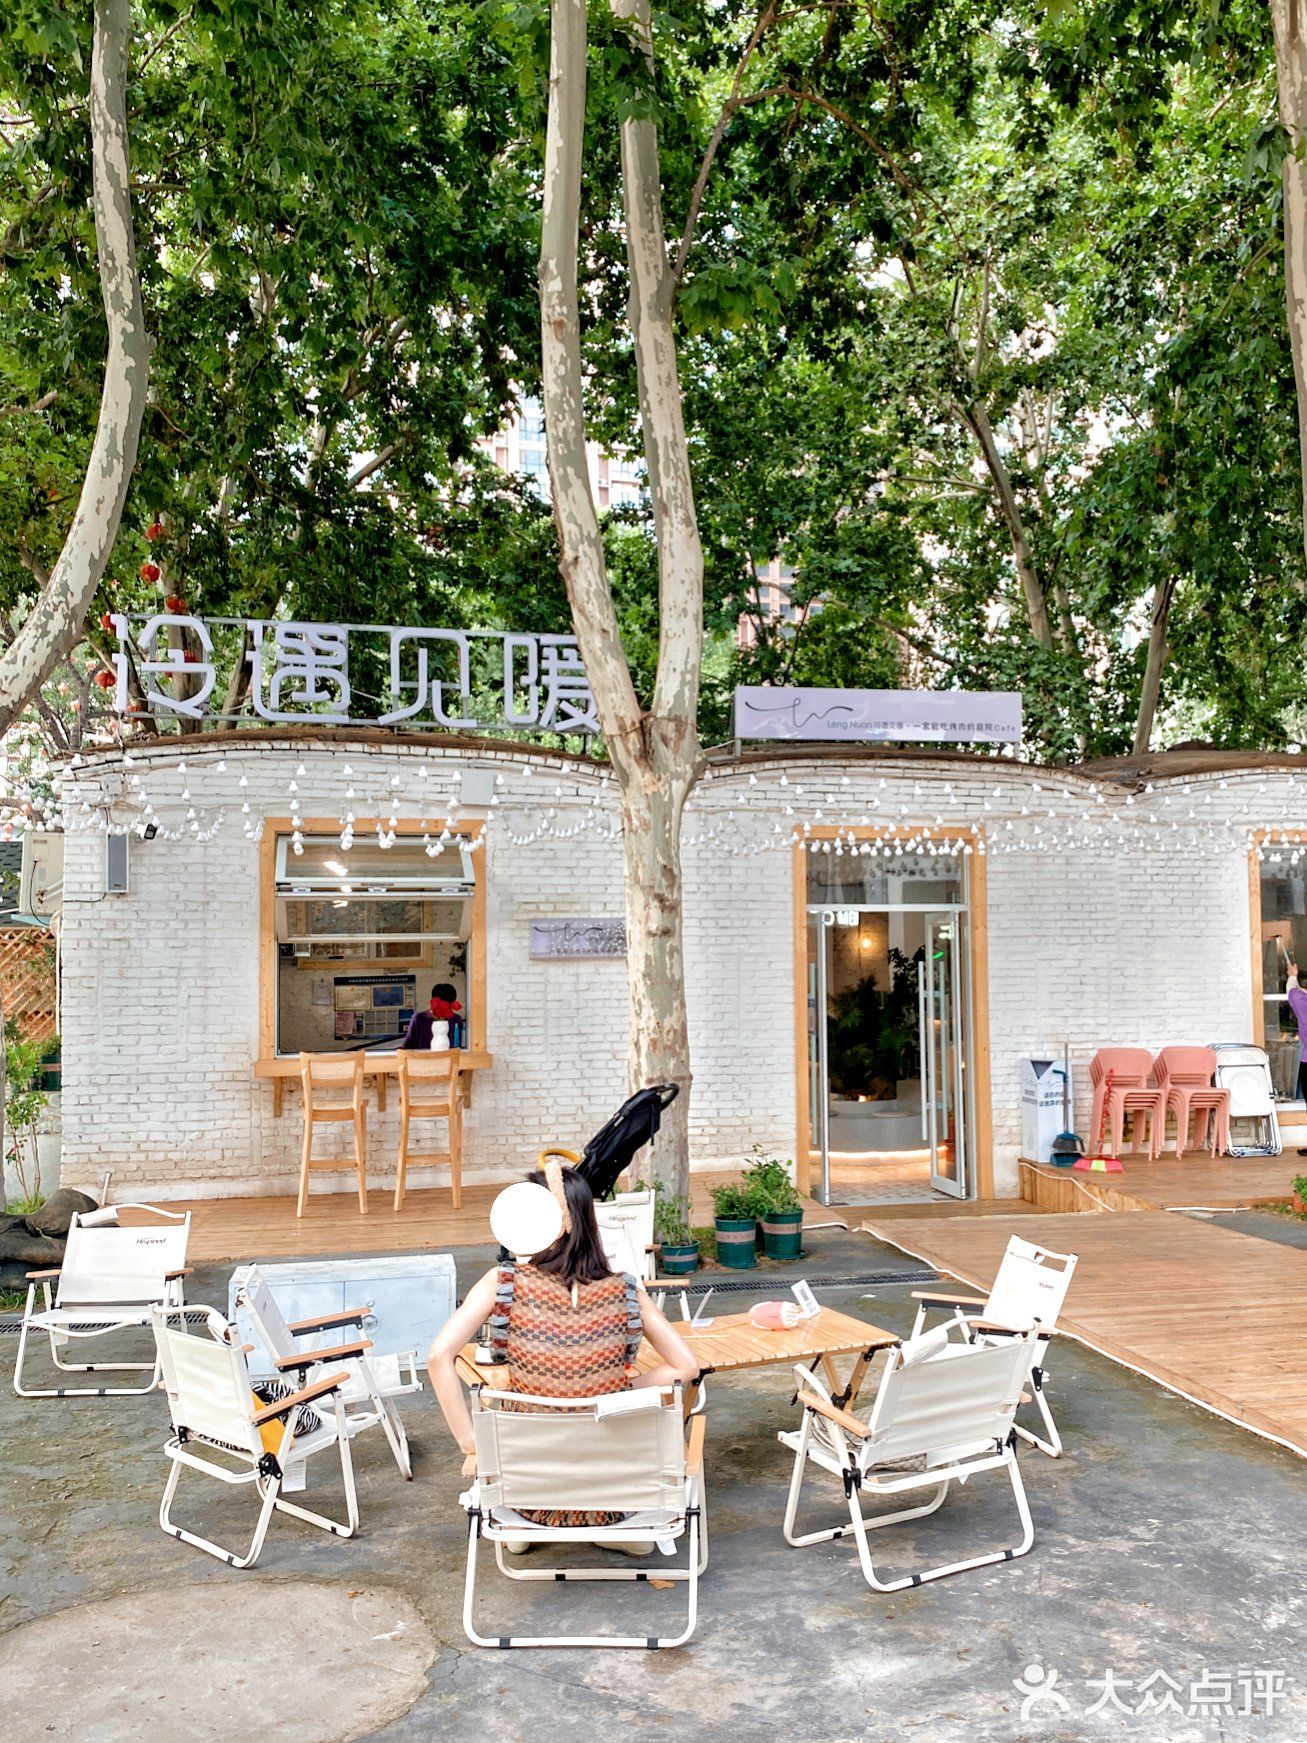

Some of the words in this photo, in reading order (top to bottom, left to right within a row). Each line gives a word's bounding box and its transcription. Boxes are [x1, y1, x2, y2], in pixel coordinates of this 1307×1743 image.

[111, 613, 600, 732] 冷遇见暖
[827, 720, 848, 730] Leng
